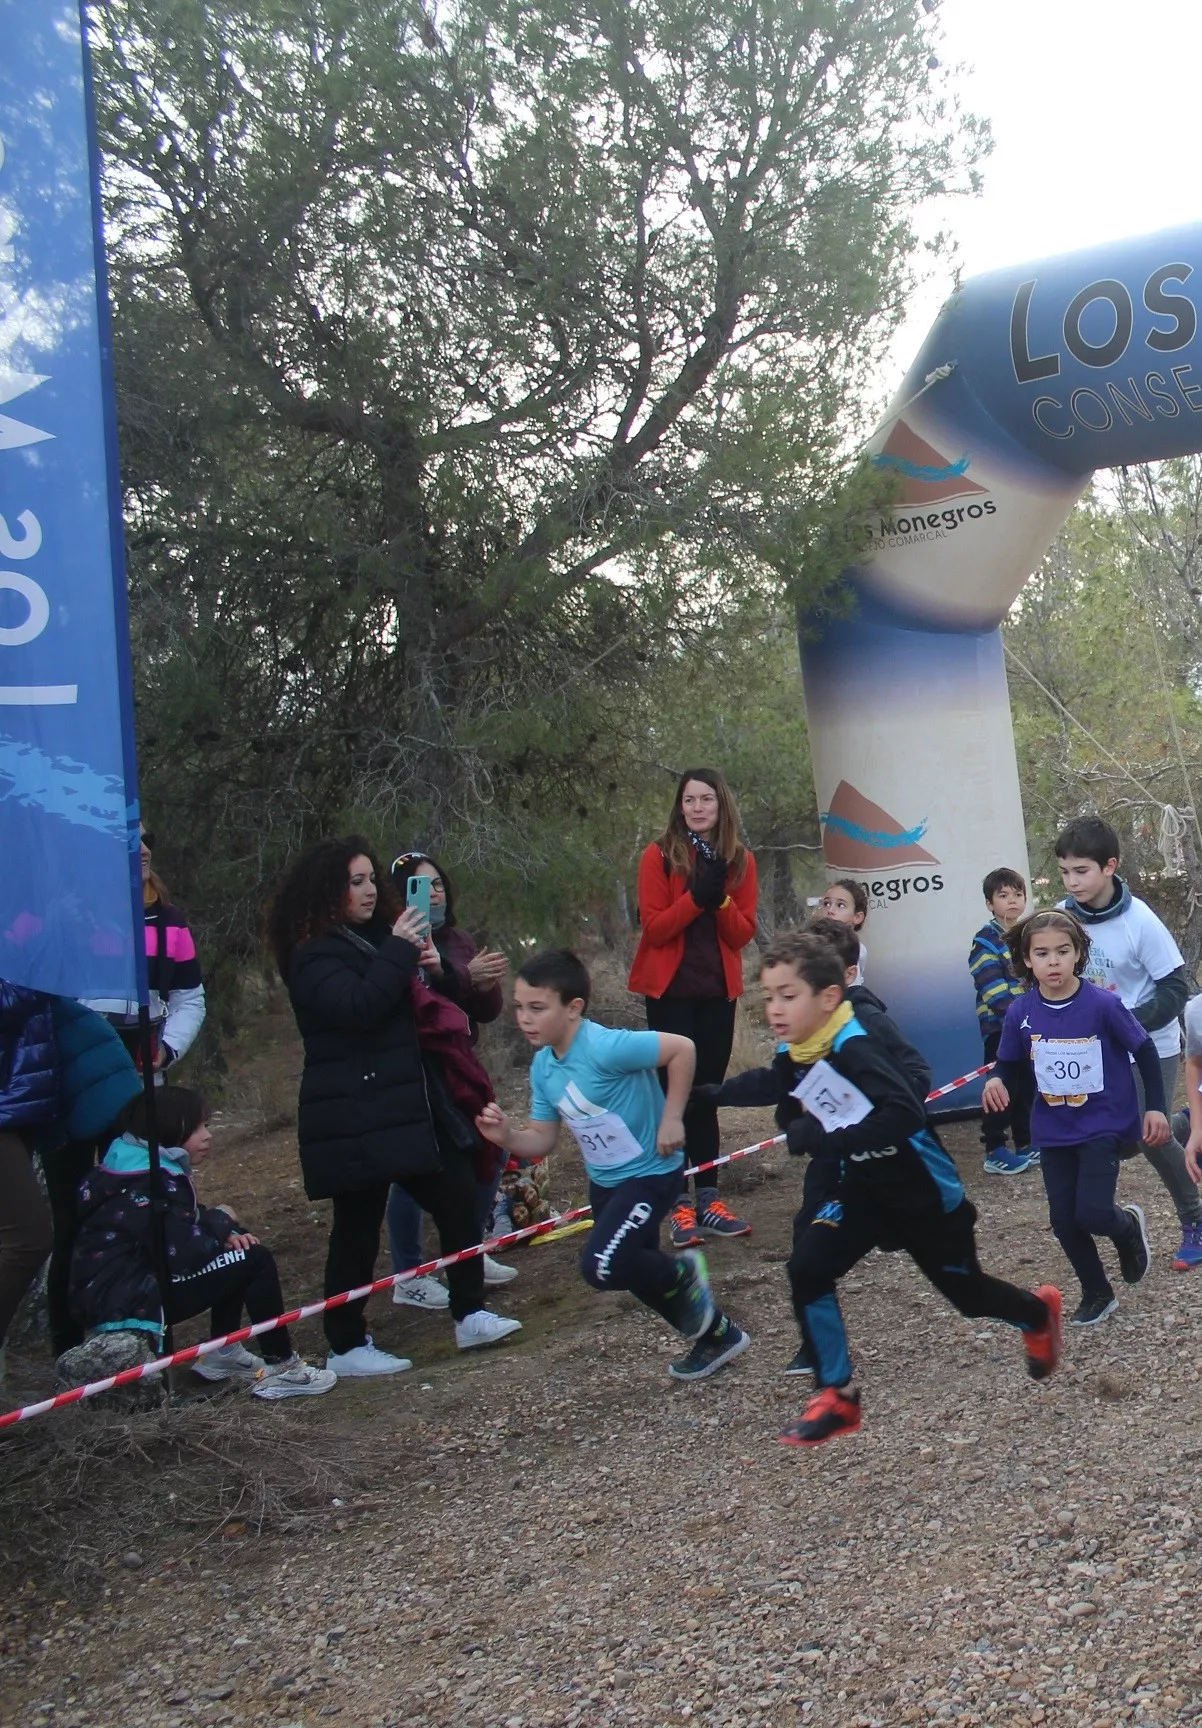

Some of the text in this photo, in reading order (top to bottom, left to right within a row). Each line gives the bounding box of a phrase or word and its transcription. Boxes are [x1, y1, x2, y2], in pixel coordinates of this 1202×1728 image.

[1009, 262, 1197, 384] Los
[880, 500, 997, 537] Monegros
[888, 529, 948, 548] COMARCAL
[1054, 1060, 1081, 1080] 30
[581, 1133, 608, 1151] 31
